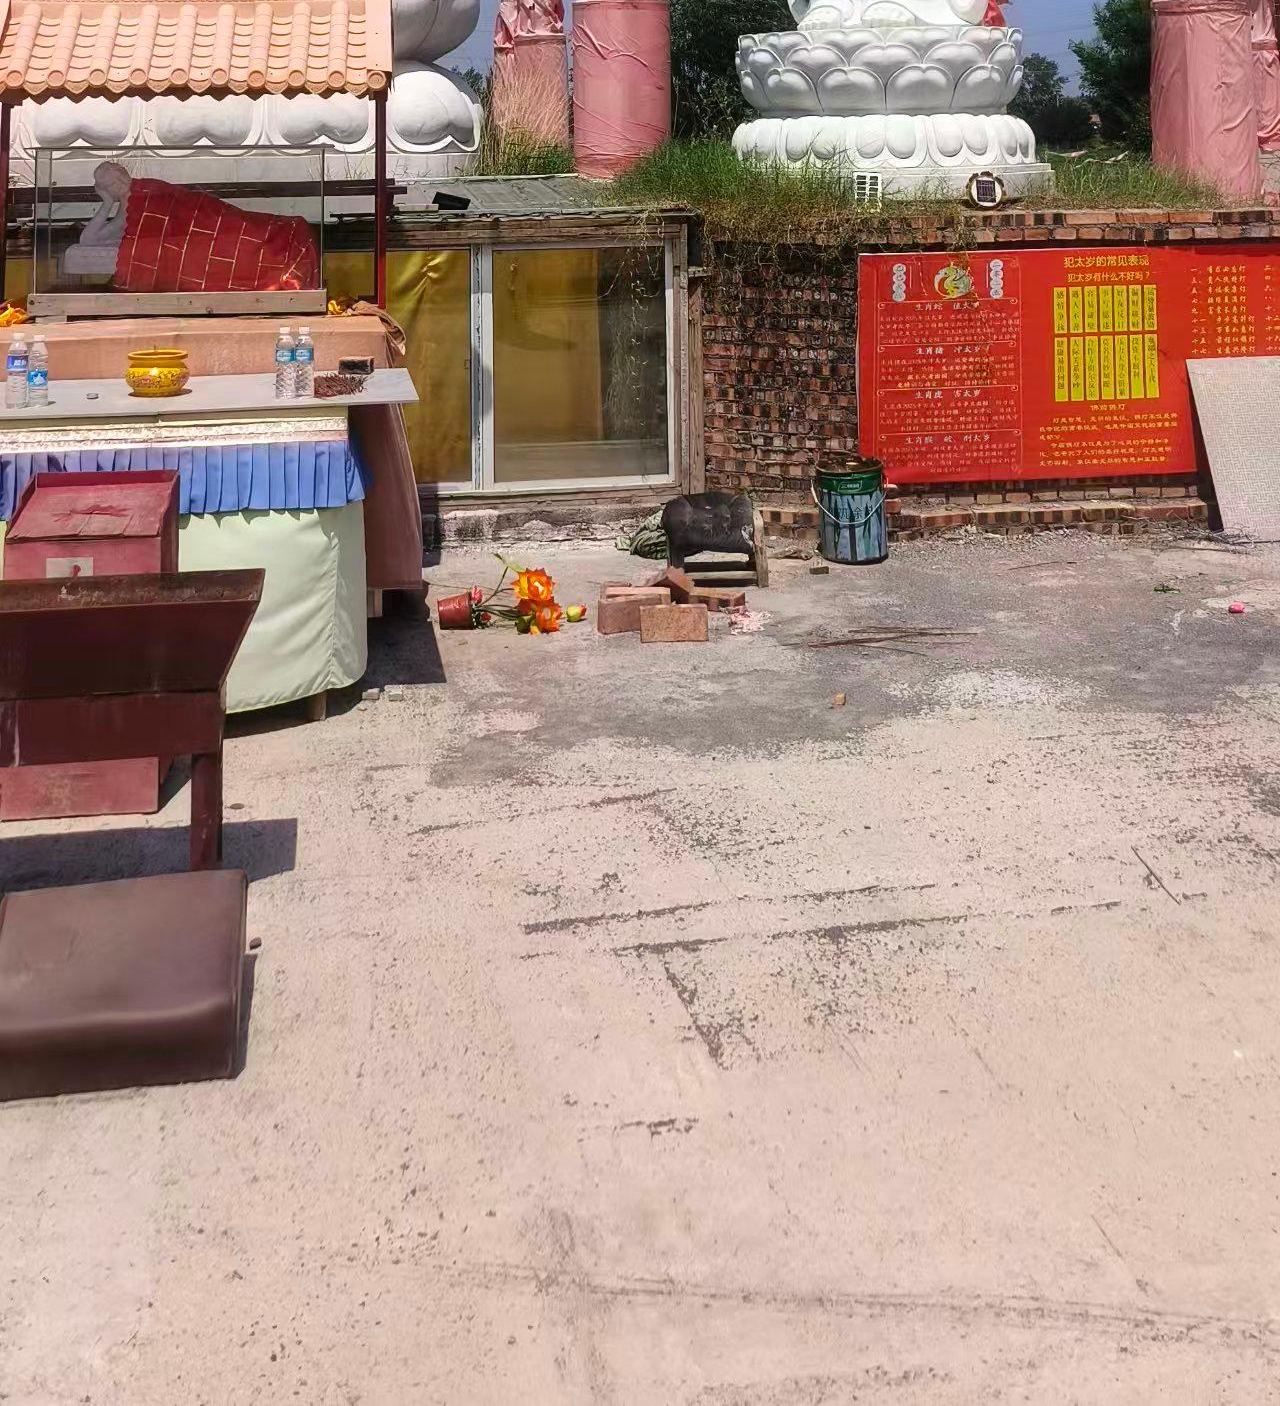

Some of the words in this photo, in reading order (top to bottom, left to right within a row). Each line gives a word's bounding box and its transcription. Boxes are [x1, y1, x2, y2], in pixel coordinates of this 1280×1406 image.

[1064, 254, 1150, 268] 犯太岁的常见表现
[1067, 271, 1151, 283] 犯太岁有什么不好吗？
